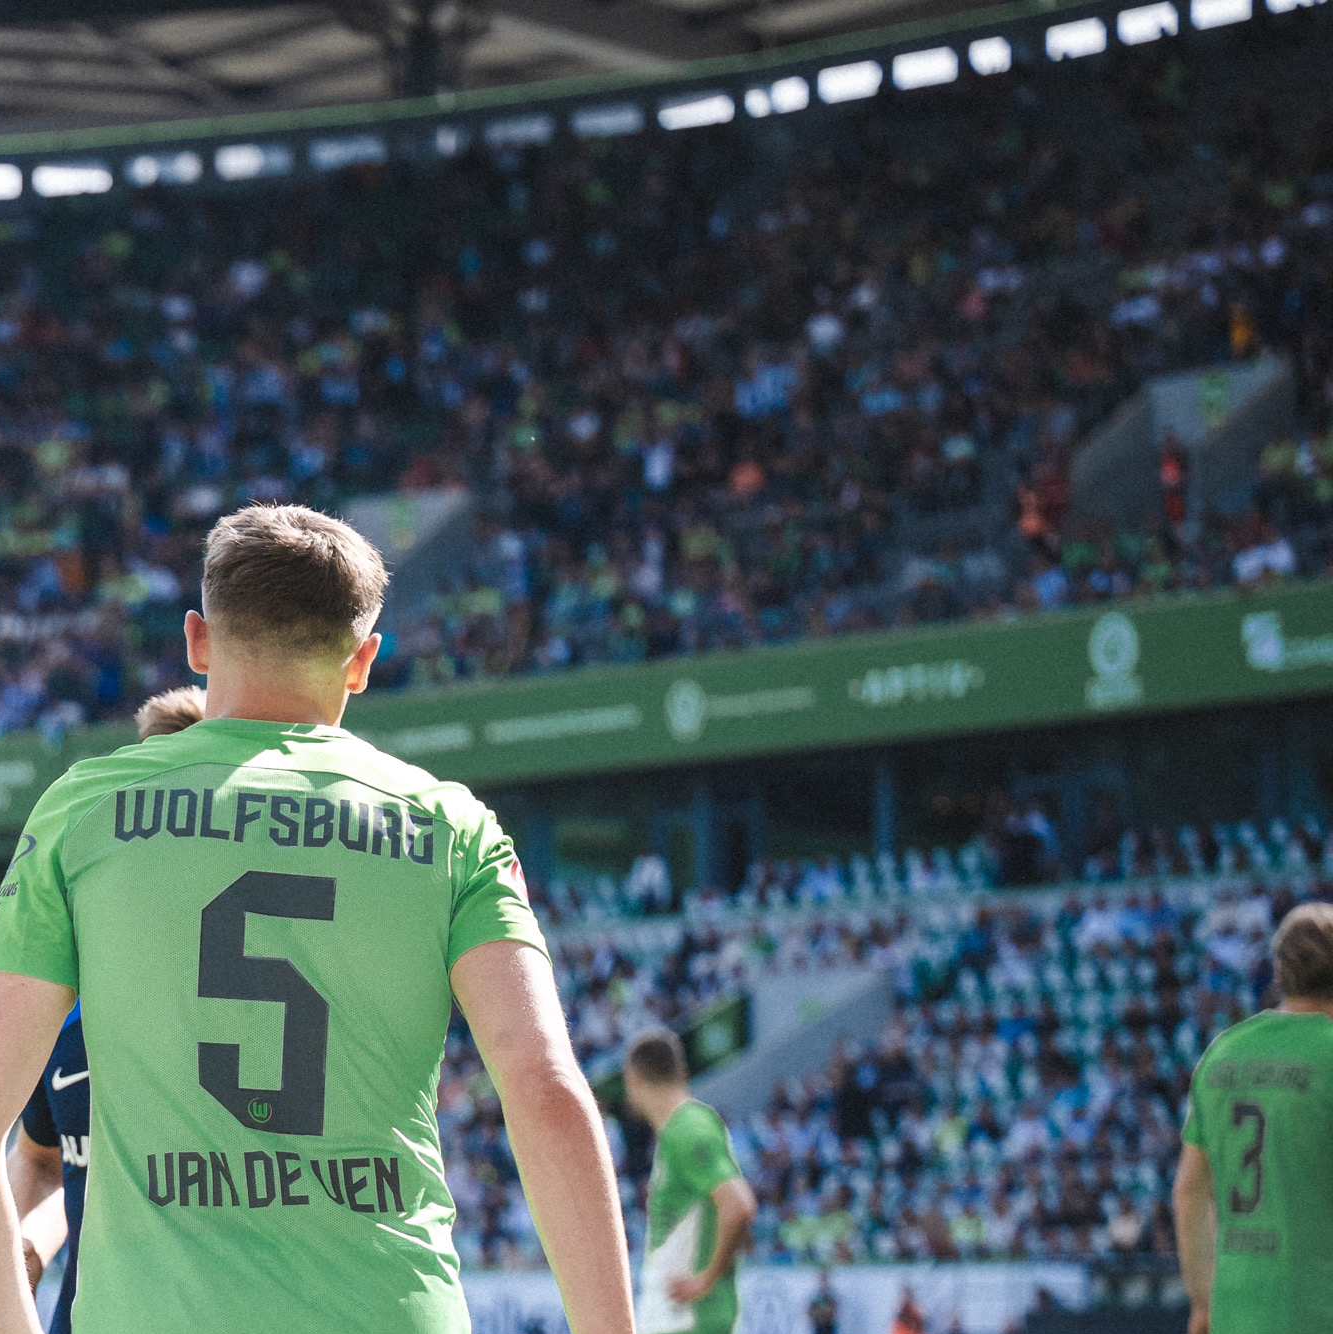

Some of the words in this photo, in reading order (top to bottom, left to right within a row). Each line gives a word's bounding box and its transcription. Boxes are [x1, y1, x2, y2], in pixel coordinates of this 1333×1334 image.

[114, 787, 434, 866] WOLFSBURG
[197, 869, 337, 1137] 5
[147, 1151, 240, 1207] VAN
[243, 1150, 310, 1209] DE
[309, 1157, 406, 1213] VEN
[1229, 1102, 1266, 1215] 3
